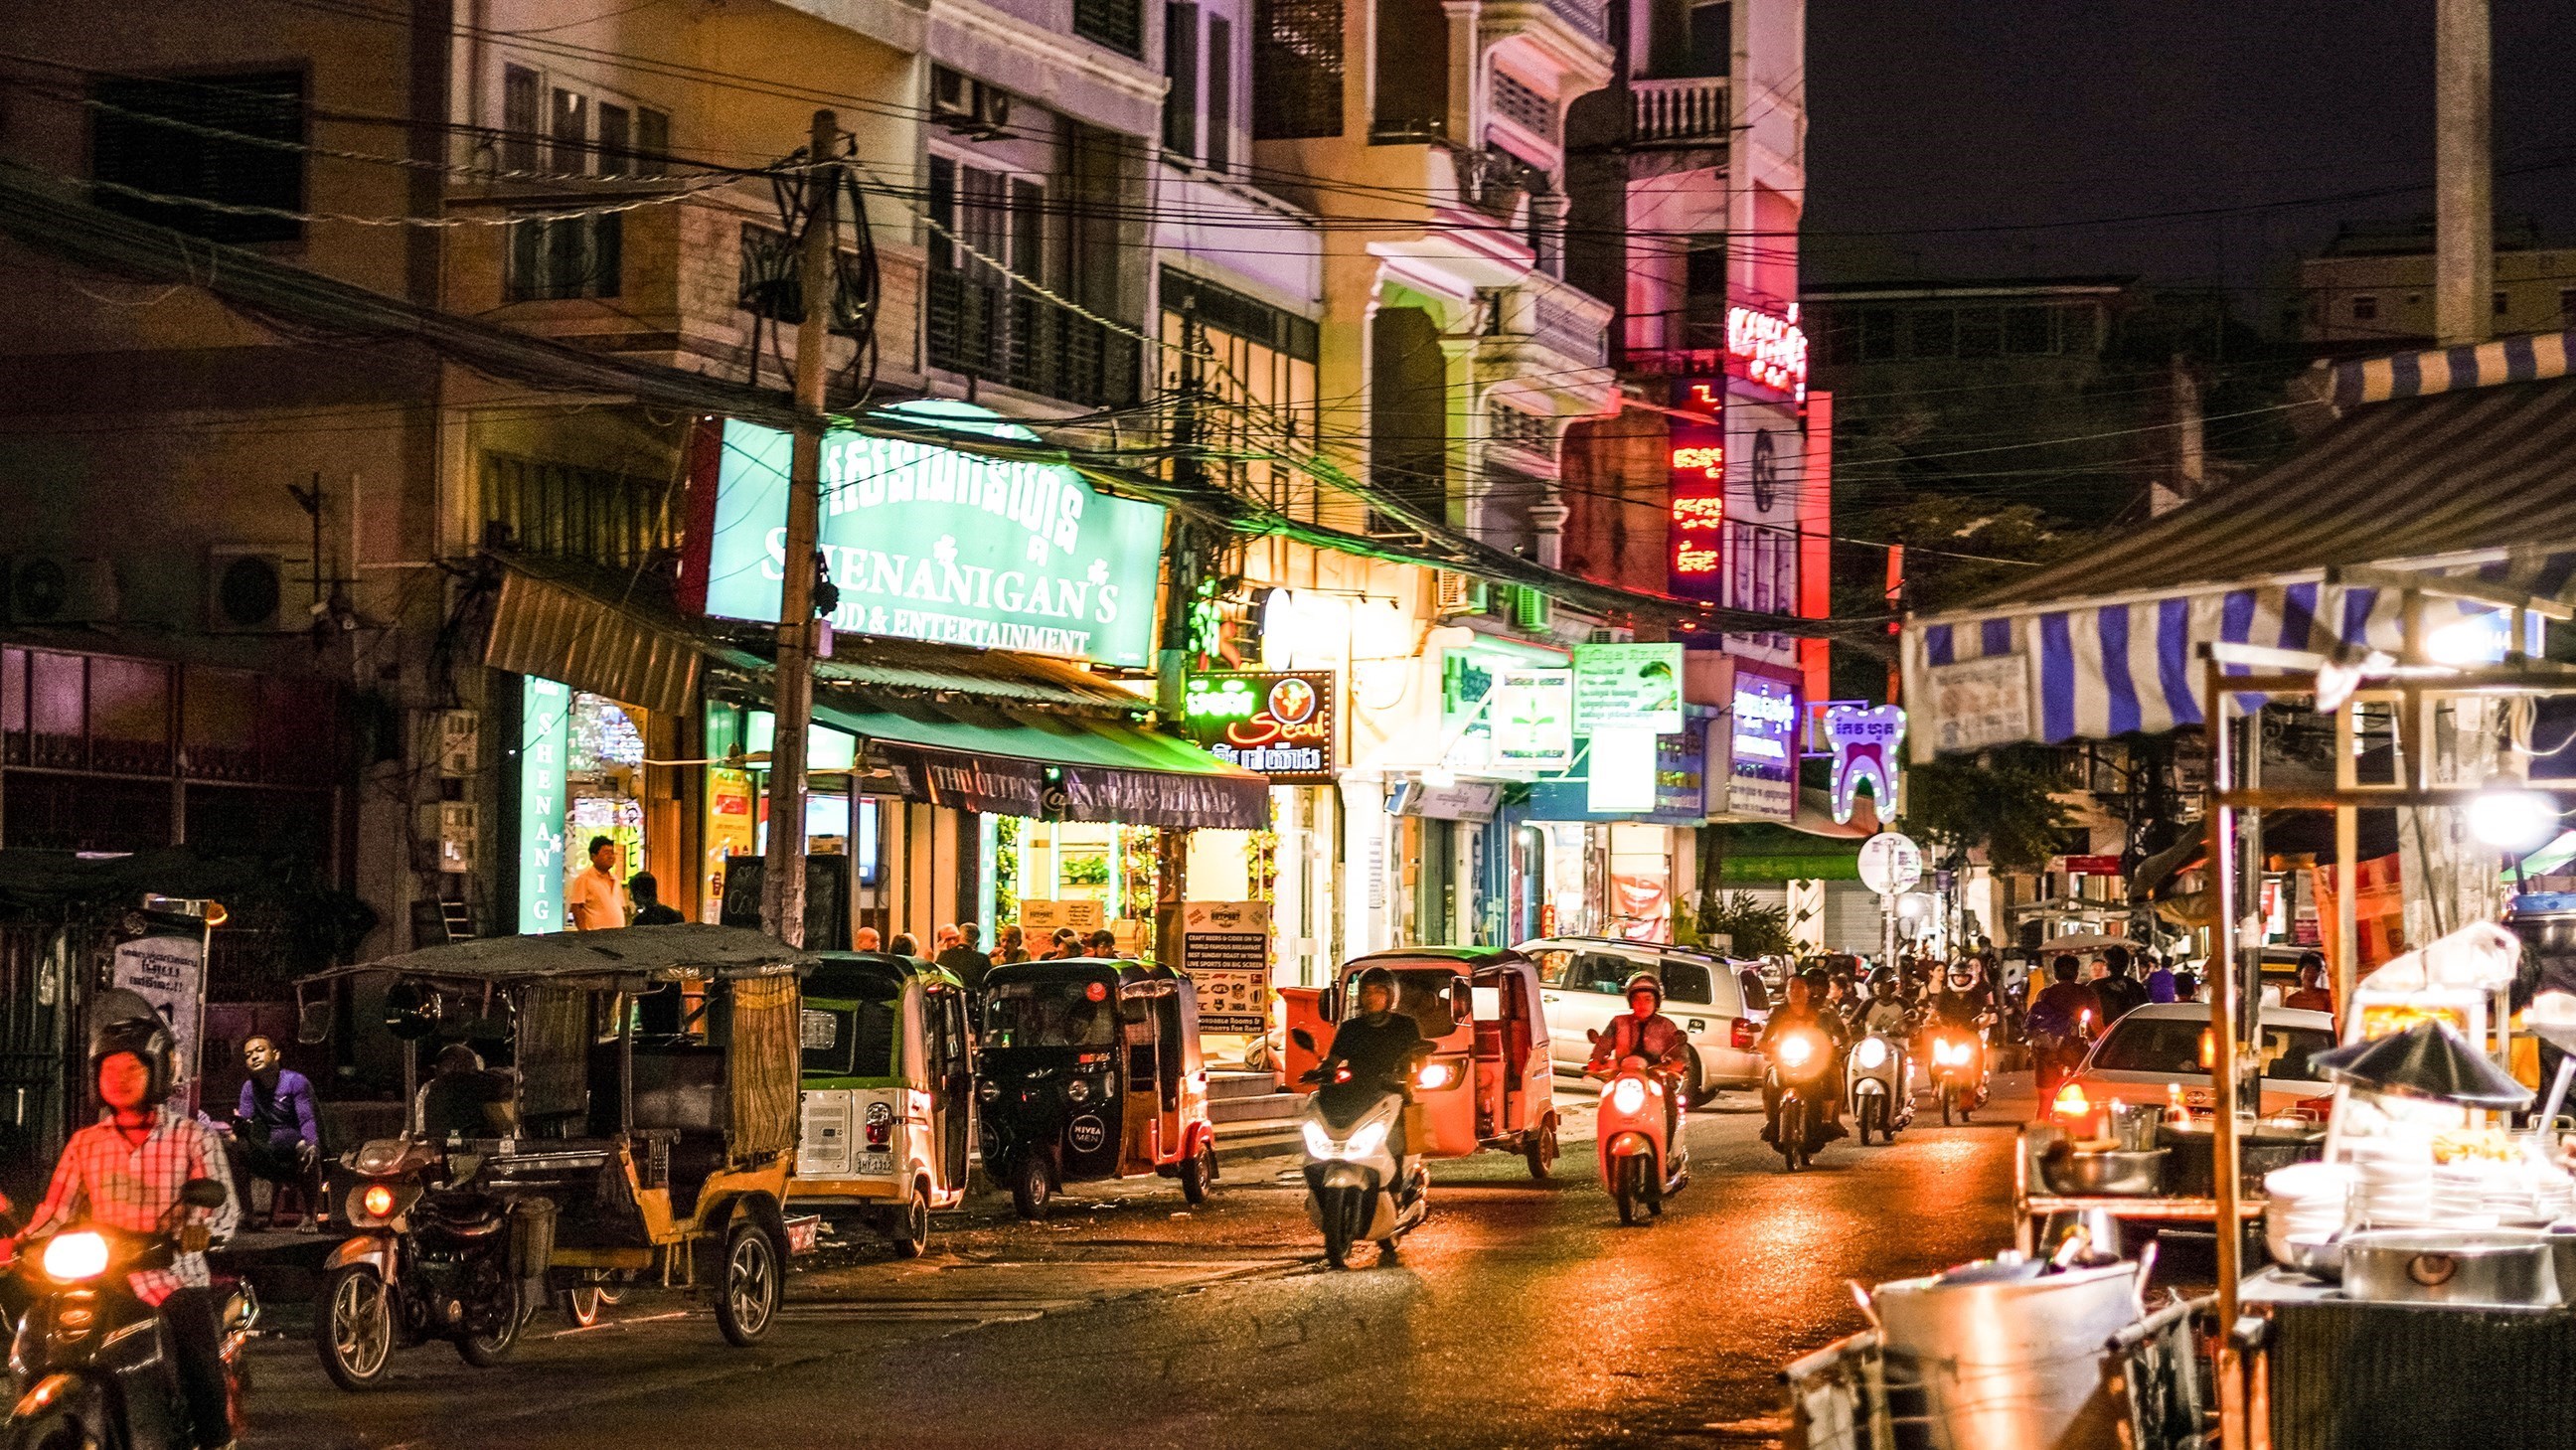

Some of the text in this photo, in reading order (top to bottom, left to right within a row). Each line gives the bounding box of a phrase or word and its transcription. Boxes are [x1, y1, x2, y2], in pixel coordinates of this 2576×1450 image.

[869, 605, 890, 634] &
[891, 608, 1091, 656] ENTERTAINMENT
[1227, 710, 1326, 744] Seoul
[975, 771, 1042, 802] OUTPOS
[1074, 1125, 1101, 1135] NIVEA
[1076, 1133, 1099, 1143] MEN
